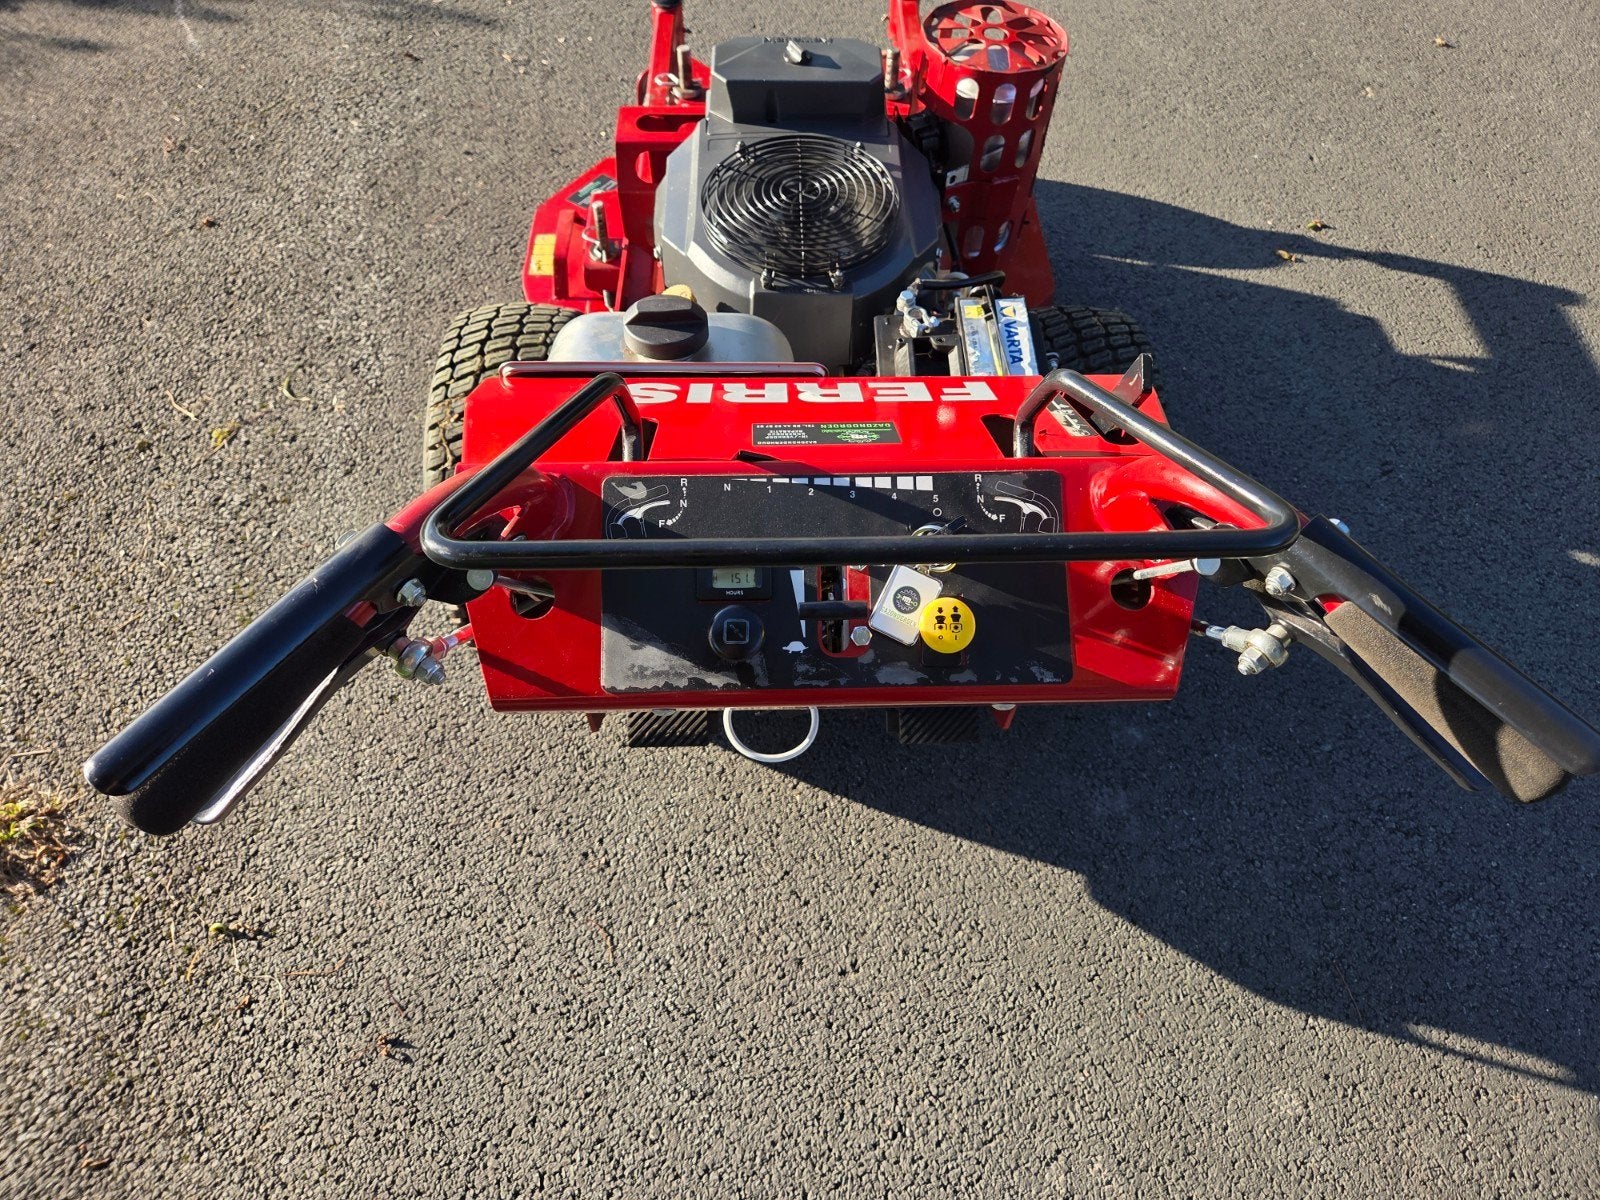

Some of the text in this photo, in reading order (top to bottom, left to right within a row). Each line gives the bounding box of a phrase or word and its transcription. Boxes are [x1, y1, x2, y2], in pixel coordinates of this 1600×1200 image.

[1004, 320, 1024, 365] VARTA
[627, 381, 998, 404] FERRIS
[680, 478, 688, 487] R
[974, 474, 982, 482] R
[723, 483, 939, 503] N 1 2 3 4 5
[679, 499, 688, 508] N
[976, 495, 984, 503] N
[999, 514, 1006, 523] F
[658, 519, 665, 528] F
